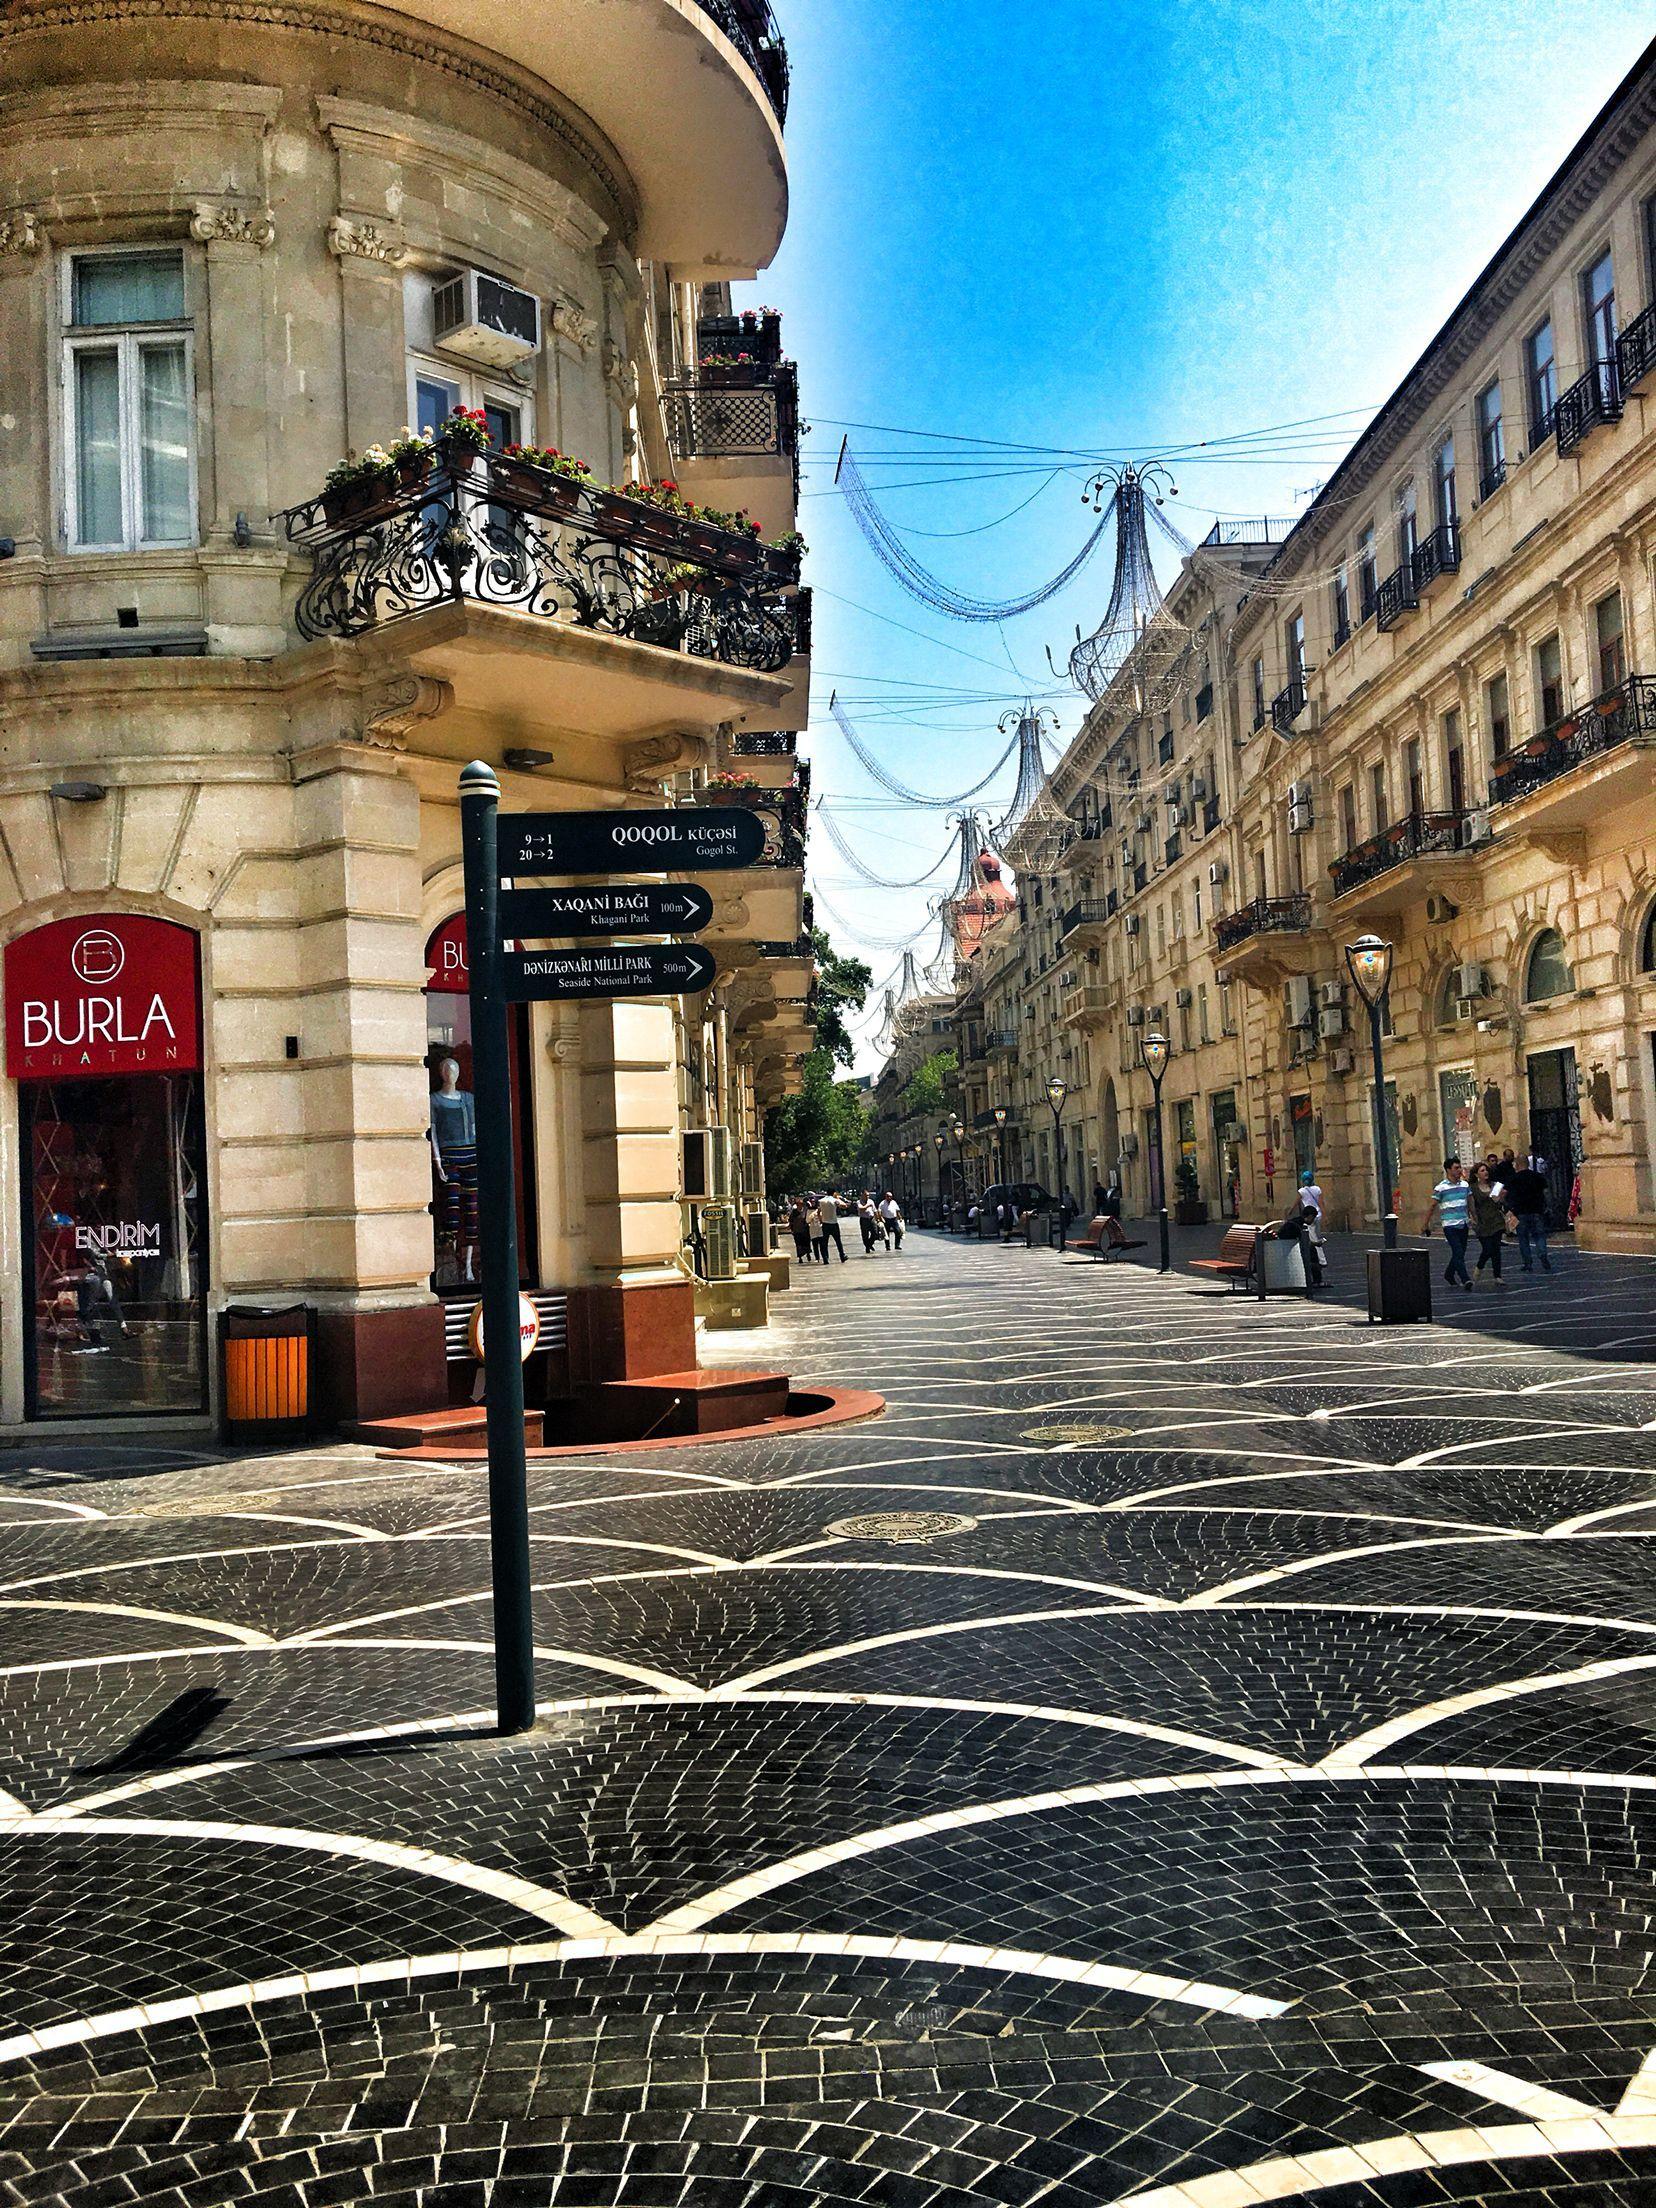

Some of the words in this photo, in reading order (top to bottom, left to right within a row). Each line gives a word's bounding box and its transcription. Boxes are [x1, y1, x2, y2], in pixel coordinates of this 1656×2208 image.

[525, 834, 532, 846] 9
[547, 833, 553, 845] 1
[611, 825, 683, 846] QOQOL
[519, 849, 533, 861] 20
[547, 848, 554, 860] 2
[696, 844, 724, 858] Gogol
[726, 844, 739, 855] St.
[552, 894, 610, 913] XAQANİ
[614, 893, 649, 909] BAĞI
[660, 902, 683, 913] 100m
[590, 913, 627, 926] Khagani
[630, 913, 650, 923] Park
[594, 955, 624, 971] MİLLİ
[625, 956, 652, 970] PARK
[662, 963, 687, 974] 500m
[558, 977, 592, 988] Seaside
[593, 976, 630, 986] National
[633, 974, 653, 985] Park
[23, 993, 176, 1047] BURLA
[25, 1046, 177, 1068] KHATUN
